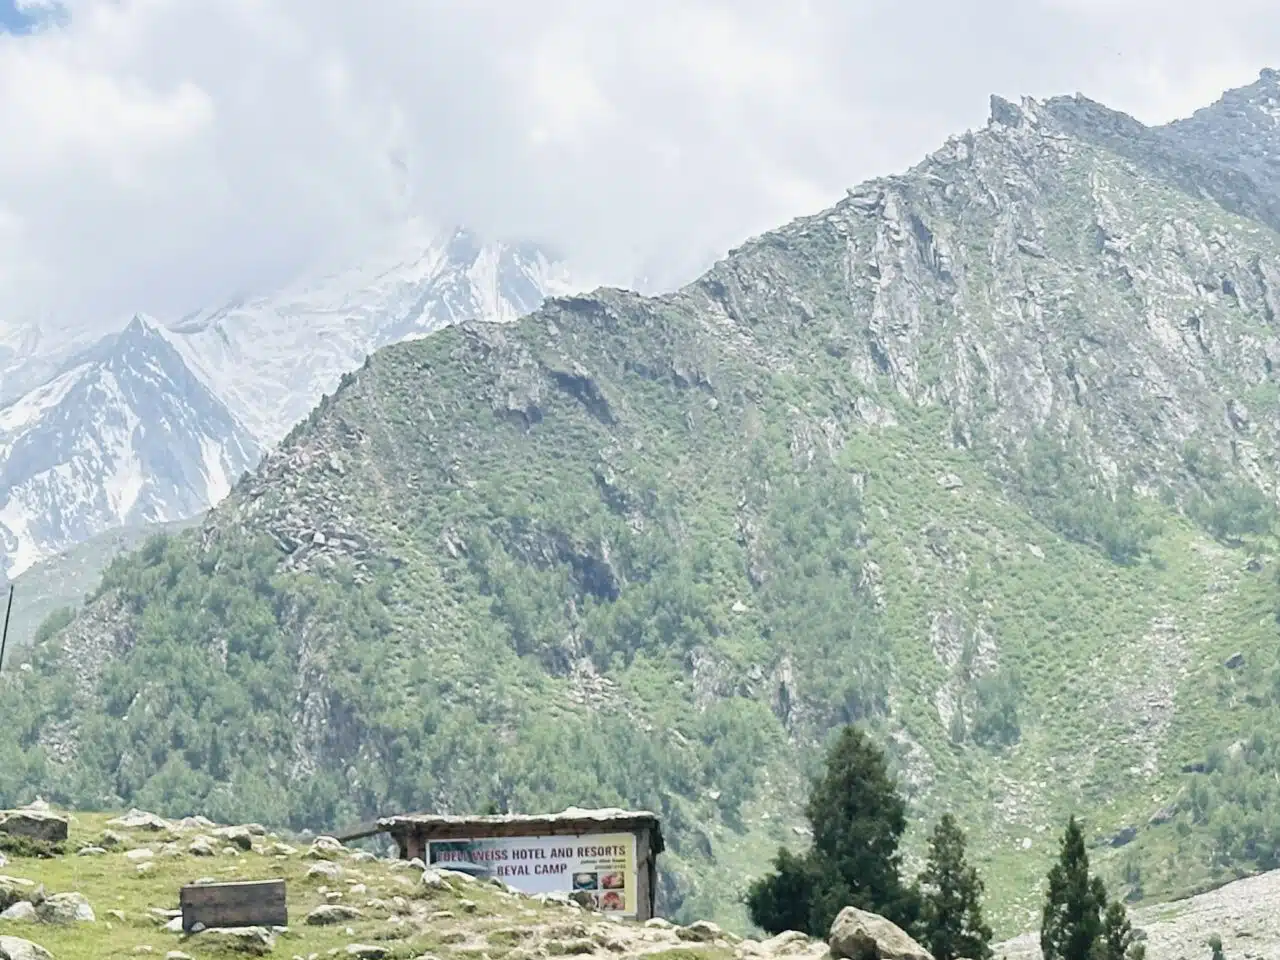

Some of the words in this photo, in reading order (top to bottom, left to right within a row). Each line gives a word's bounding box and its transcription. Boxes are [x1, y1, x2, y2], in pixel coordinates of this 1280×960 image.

[512, 848, 546, 860] HOTEL
[550, 847, 573, 859] AND
[577, 845, 626, 858] RESORTS
[497, 865, 530, 876] BEYAL
[534, 863, 567, 875] CAMP
